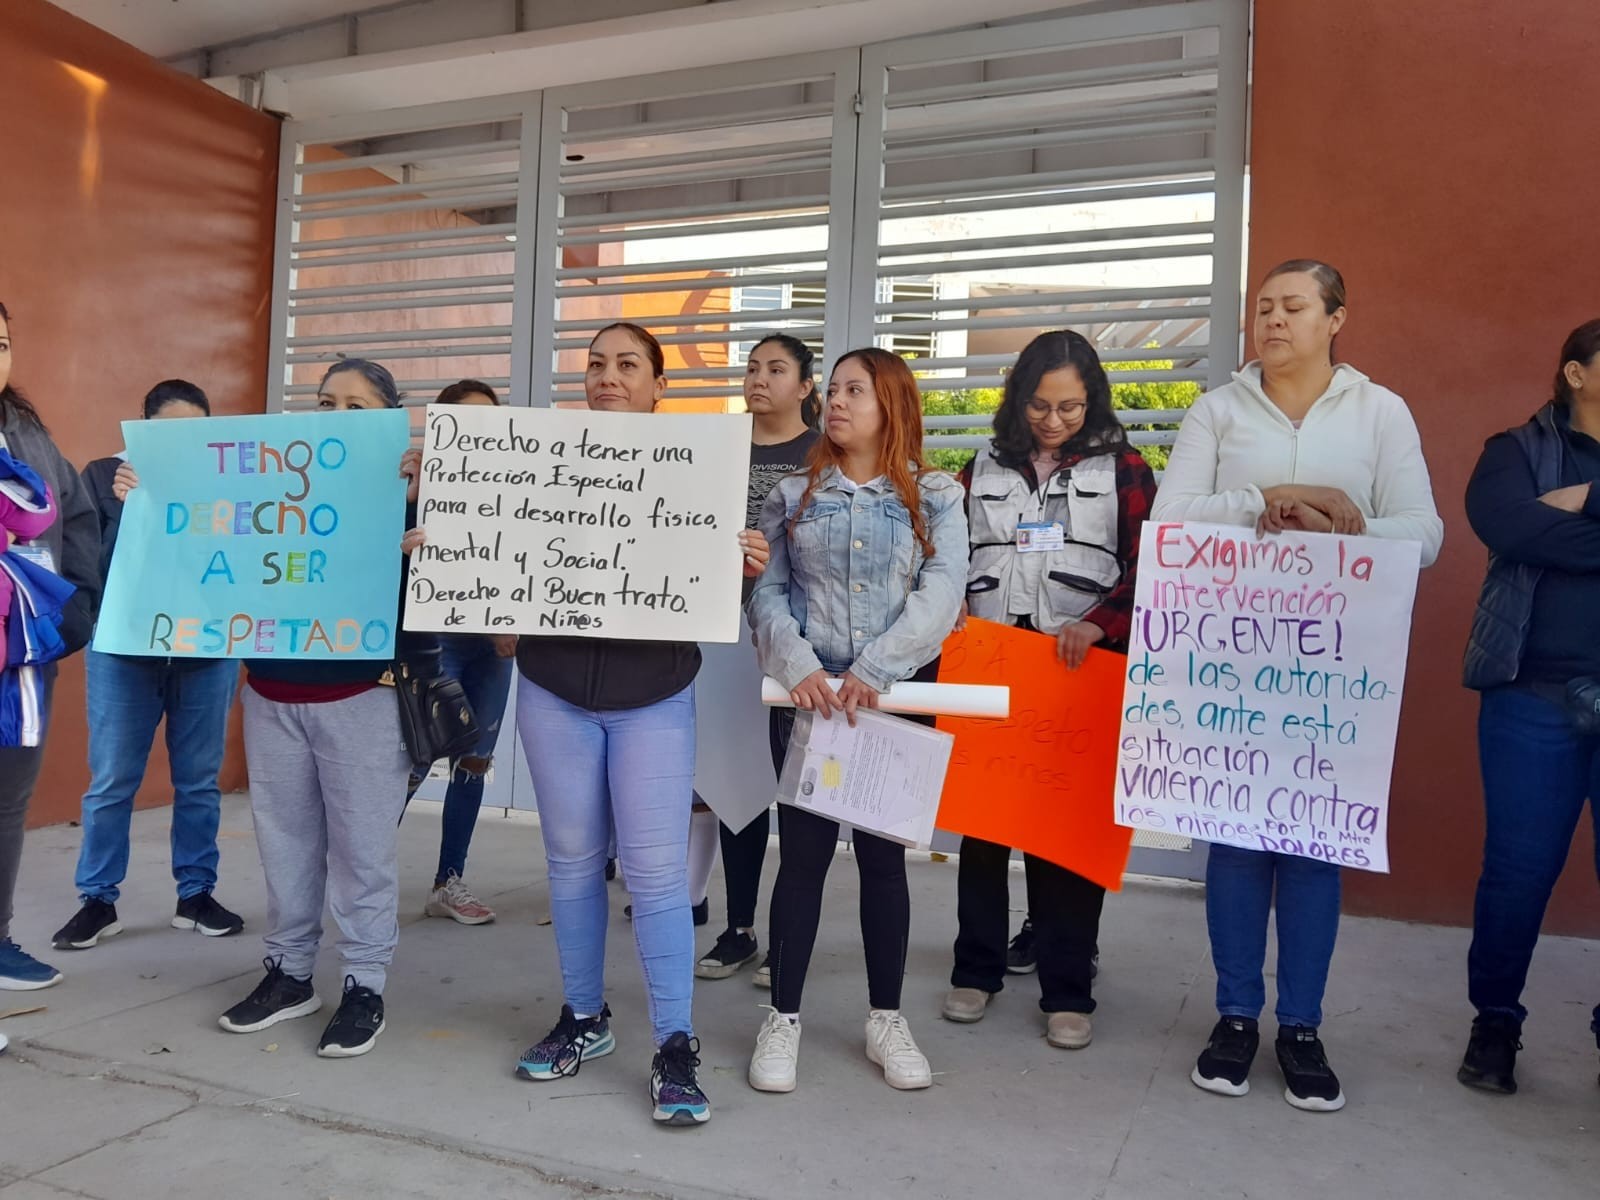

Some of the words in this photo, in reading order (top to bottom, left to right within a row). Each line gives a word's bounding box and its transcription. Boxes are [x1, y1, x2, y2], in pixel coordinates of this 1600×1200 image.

[550, 441, 565, 458] a
[574, 428, 642, 462] tener
[653, 445, 693, 465] una
[751, 463, 797, 471] DIVISION
[424, 456, 536, 485] Protección
[544, 465, 645, 497] Especial
[423, 498, 466, 525] para
[478, 494, 501, 517] el
[514, 497, 631, 528] desarrollo
[201, 550, 234, 584] A
[262, 550, 327, 585] SER
[419, 531, 501, 562] mental
[514, 552, 527, 574] y
[1156, 523, 1313, 585] Exigimos
[1339, 540, 1373, 582] la
[511, 575, 533, 602] al
[544, 577, 605, 606] Buen
[149, 613, 390, 655] RESPETADO
[444, 607, 466, 626] de
[484, 607, 516, 627] los
[1134, 606, 1343, 661] ¡URGENTE!
[1129, 650, 1168, 686] de
[1188, 650, 1241, 691] las
[1197, 693, 1266, 735] ante
[1282, 703, 1359, 744] está
[1121, 728, 1269, 776] situación
[1293, 742, 1335, 781] de
[1267, 783, 1380, 834] contra
[1312, 824, 1327, 840] la
